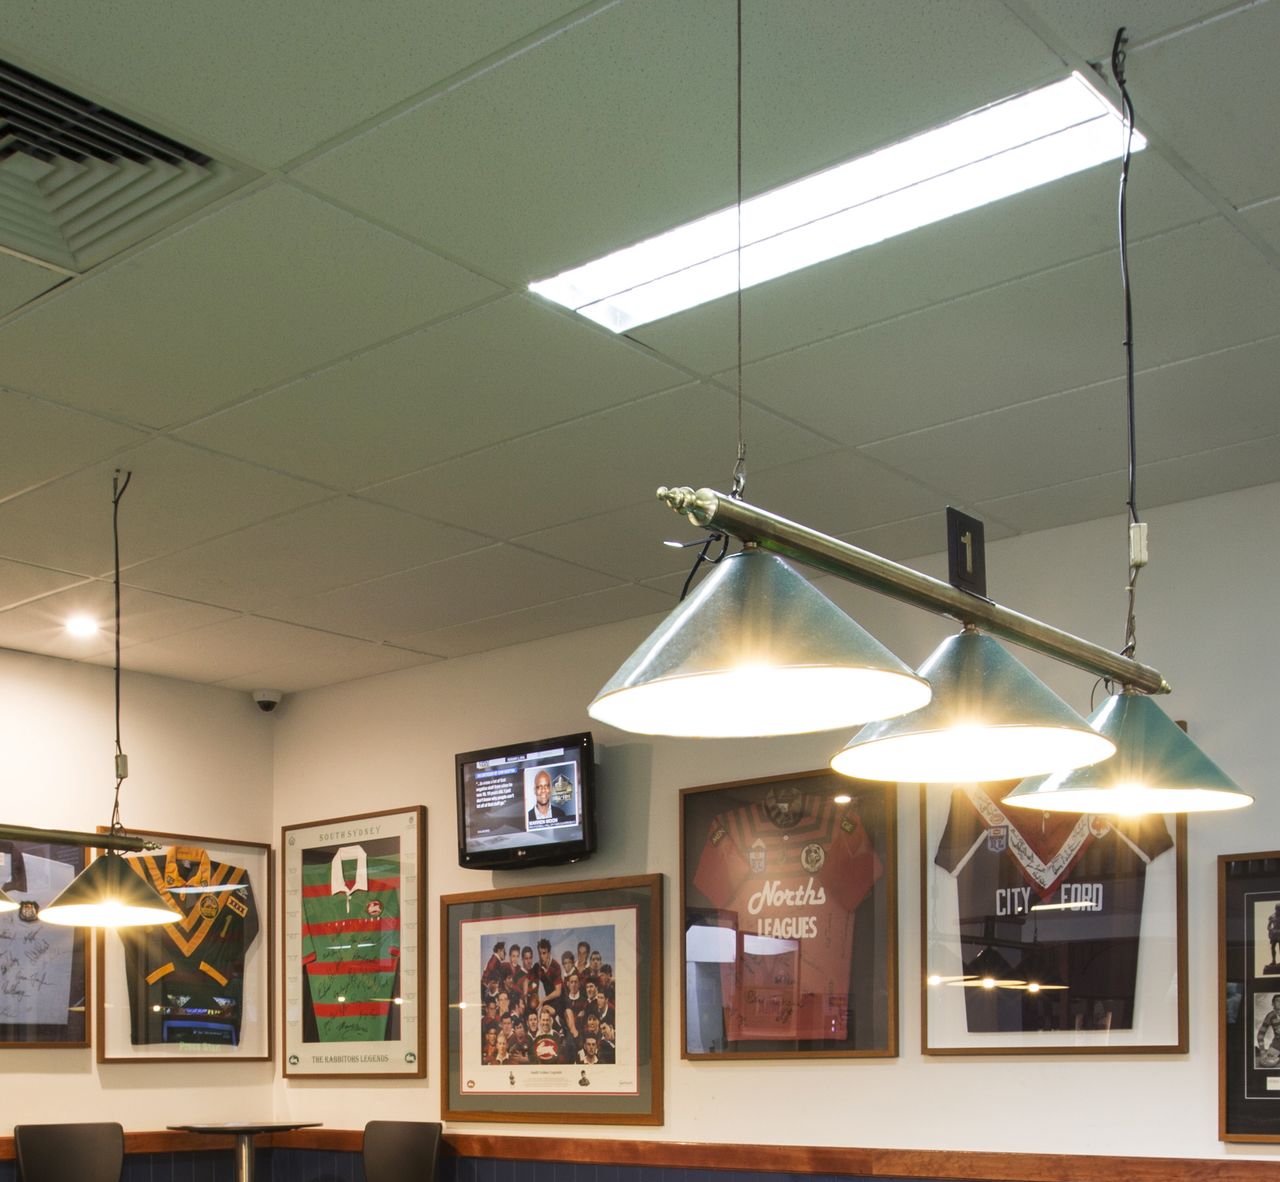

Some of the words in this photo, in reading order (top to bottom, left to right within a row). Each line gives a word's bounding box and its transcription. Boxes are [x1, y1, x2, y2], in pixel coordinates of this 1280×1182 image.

[961, 531, 973, 575] 1
[319, 831, 346, 841] SOUTH
[347, 826, 381, 839] SYDNEY
[747, 877, 826, 915] Norths
[995, 887, 1031, 916] CITY
[1060, 883, 1103, 912] FORD
[757, 916, 818, 938] LEAGUES
